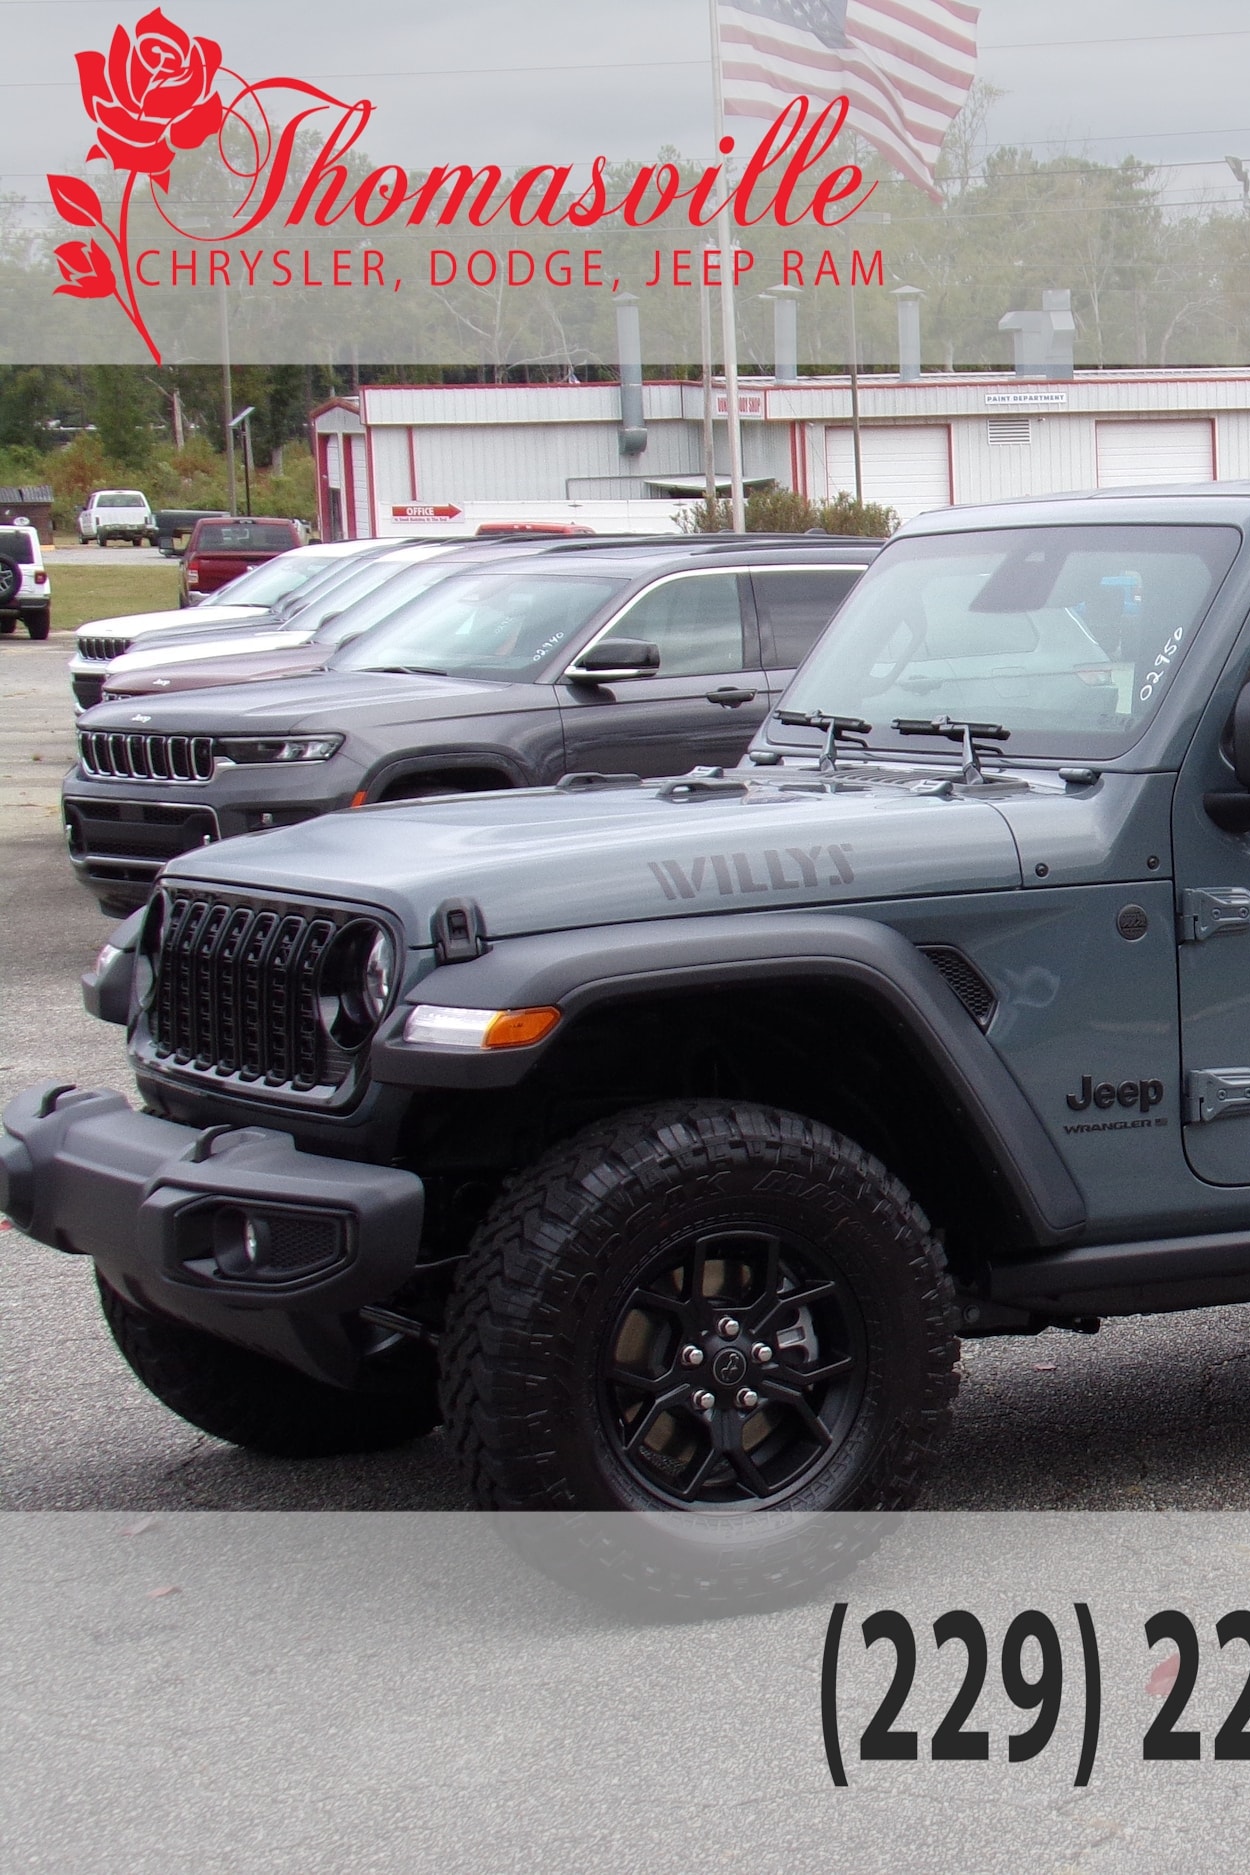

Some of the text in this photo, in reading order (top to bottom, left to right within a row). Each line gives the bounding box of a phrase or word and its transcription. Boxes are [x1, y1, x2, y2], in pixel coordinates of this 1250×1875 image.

[406, 507, 435, 516] OFFICE
[1139, 626, 1184, 702] 02950
[647, 843, 855, 901] WILLYS
[1065, 1073, 1165, 1113] Jeep
[1063, 1119, 1152, 1135] WRANGLER
